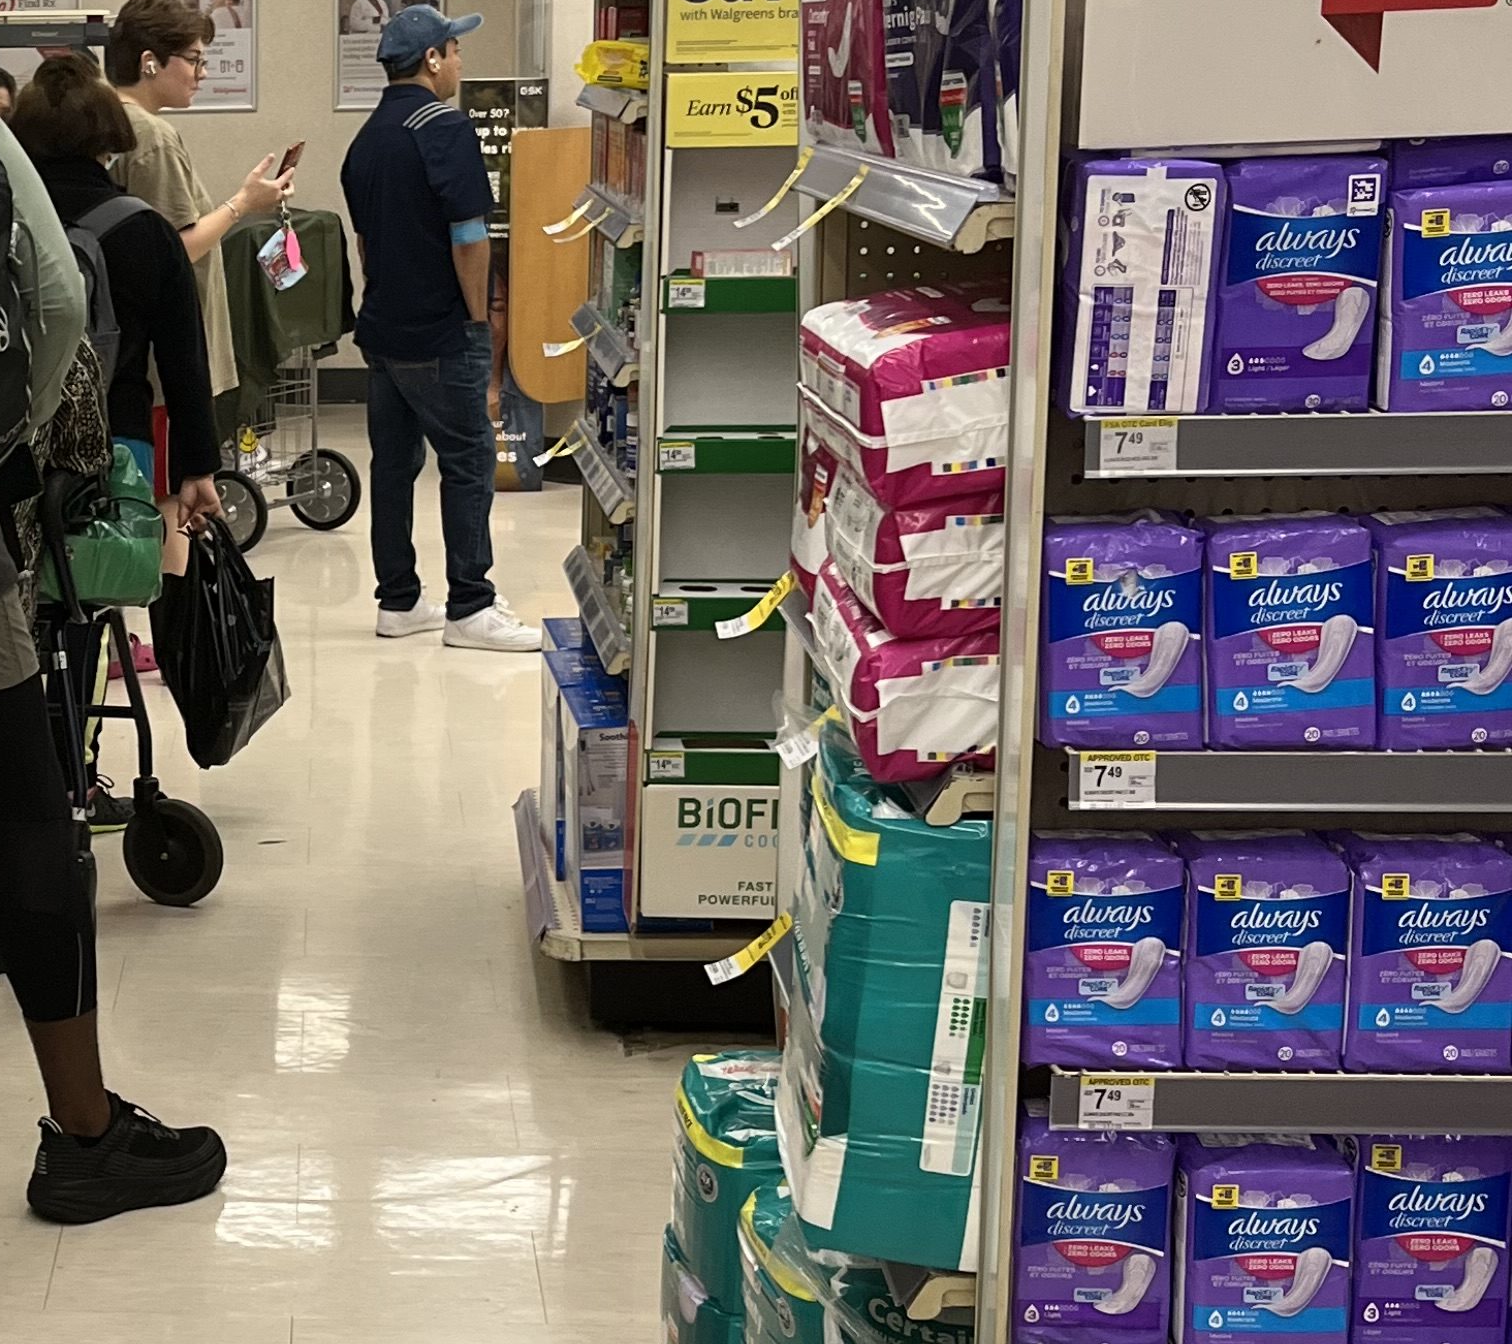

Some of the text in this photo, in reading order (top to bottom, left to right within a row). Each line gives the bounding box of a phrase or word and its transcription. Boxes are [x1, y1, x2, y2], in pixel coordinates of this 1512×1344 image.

[680, 8, 707, 21] with
[710, 7, 775, 24] Walgreens
[490, 108, 510, 119] 50?
[686, 98, 732, 117] Earn
[735, 84, 780, 129] $5
[493, 126, 507, 136] to
[1256, 221, 1360, 259] always
[1256, 253, 1322, 270] discreet
[1440, 265, 1504, 284] discreet
[1083, 584, 1176, 617] always
[1248, 578, 1343, 612] always
[1084, 611, 1145, 629] discreet
[1251, 607, 1309, 624] discreet
[1424, 609, 1485, 627] discreet
[1087, 753, 1150, 762] APPROVED OTC
[737, 881, 773, 892] FAST
[698, 894, 775, 906] POWERFUL
[1063, 898, 1155, 927] always
[1230, 902, 1322, 934] always
[1398, 902, 1491, 932] always
[1064, 923, 1123, 939] discreet
[1231, 930, 1291, 945] discreet
[1398, 928, 1459, 945] discreet
[1088, 1078, 1150, 1086] APPROVED OTC
[1388, 1185, 1489, 1220] always
[1046, 1193, 1146, 1230] always
[1047, 1220, 1109, 1236] discreet
[1228, 1211, 1320, 1242] always
[1389, 1212, 1454, 1229] discreet
[1229, 1236, 1289, 1251] discreet
